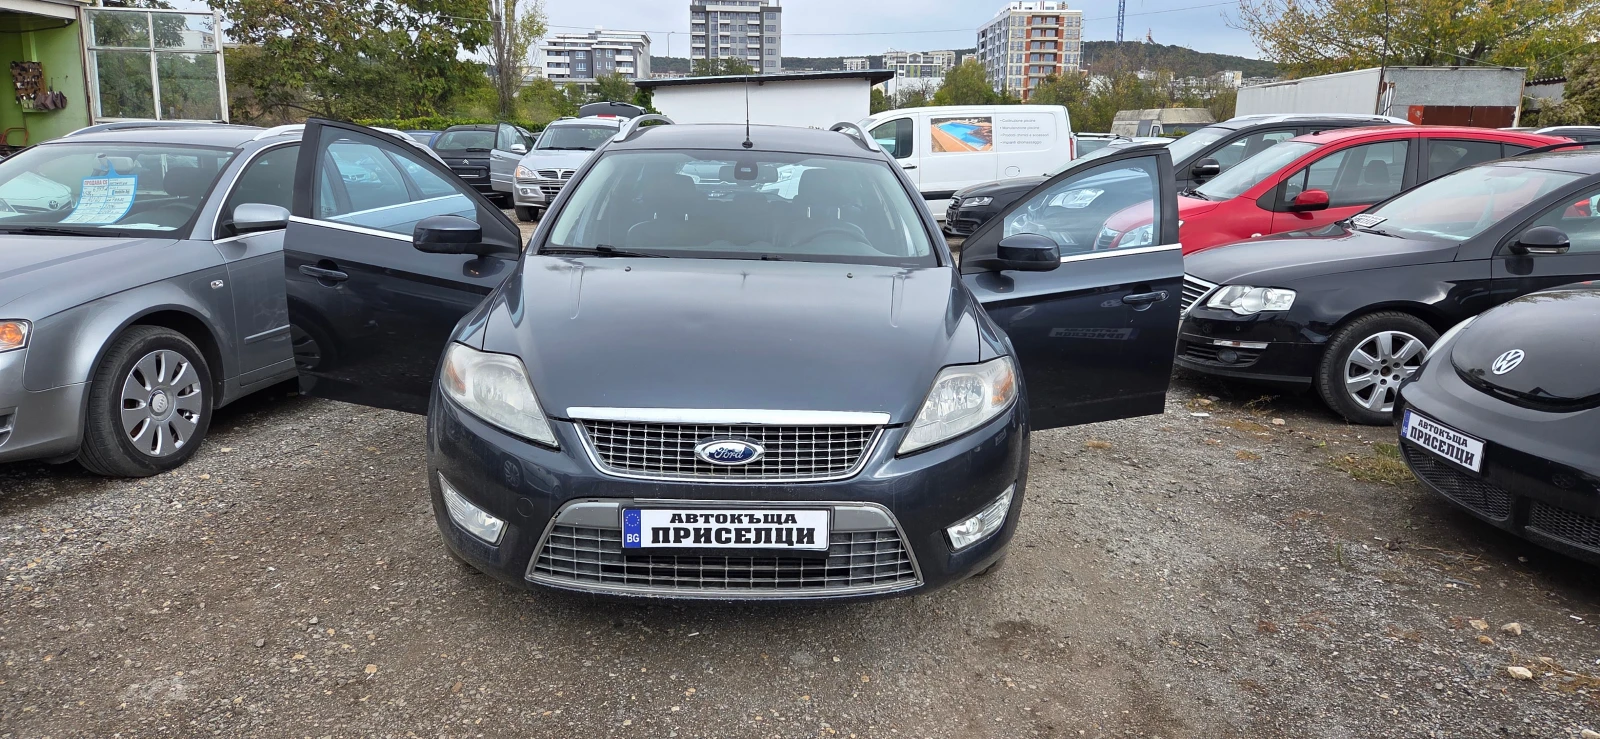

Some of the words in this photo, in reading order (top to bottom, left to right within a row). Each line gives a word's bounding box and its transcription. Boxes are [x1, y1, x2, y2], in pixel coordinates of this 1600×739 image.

[1418, 419, 1468, 448] АВТОКЪЩА
[714, 447, 744, 458] Ford
[1410, 426, 1475, 466] ПРИСЕЛЦИ
[670, 514, 798, 525] АВТОКЪЩА
[627, 533, 640, 543] BG
[651, 527, 816, 546] ПРИСЕЛЦИ
